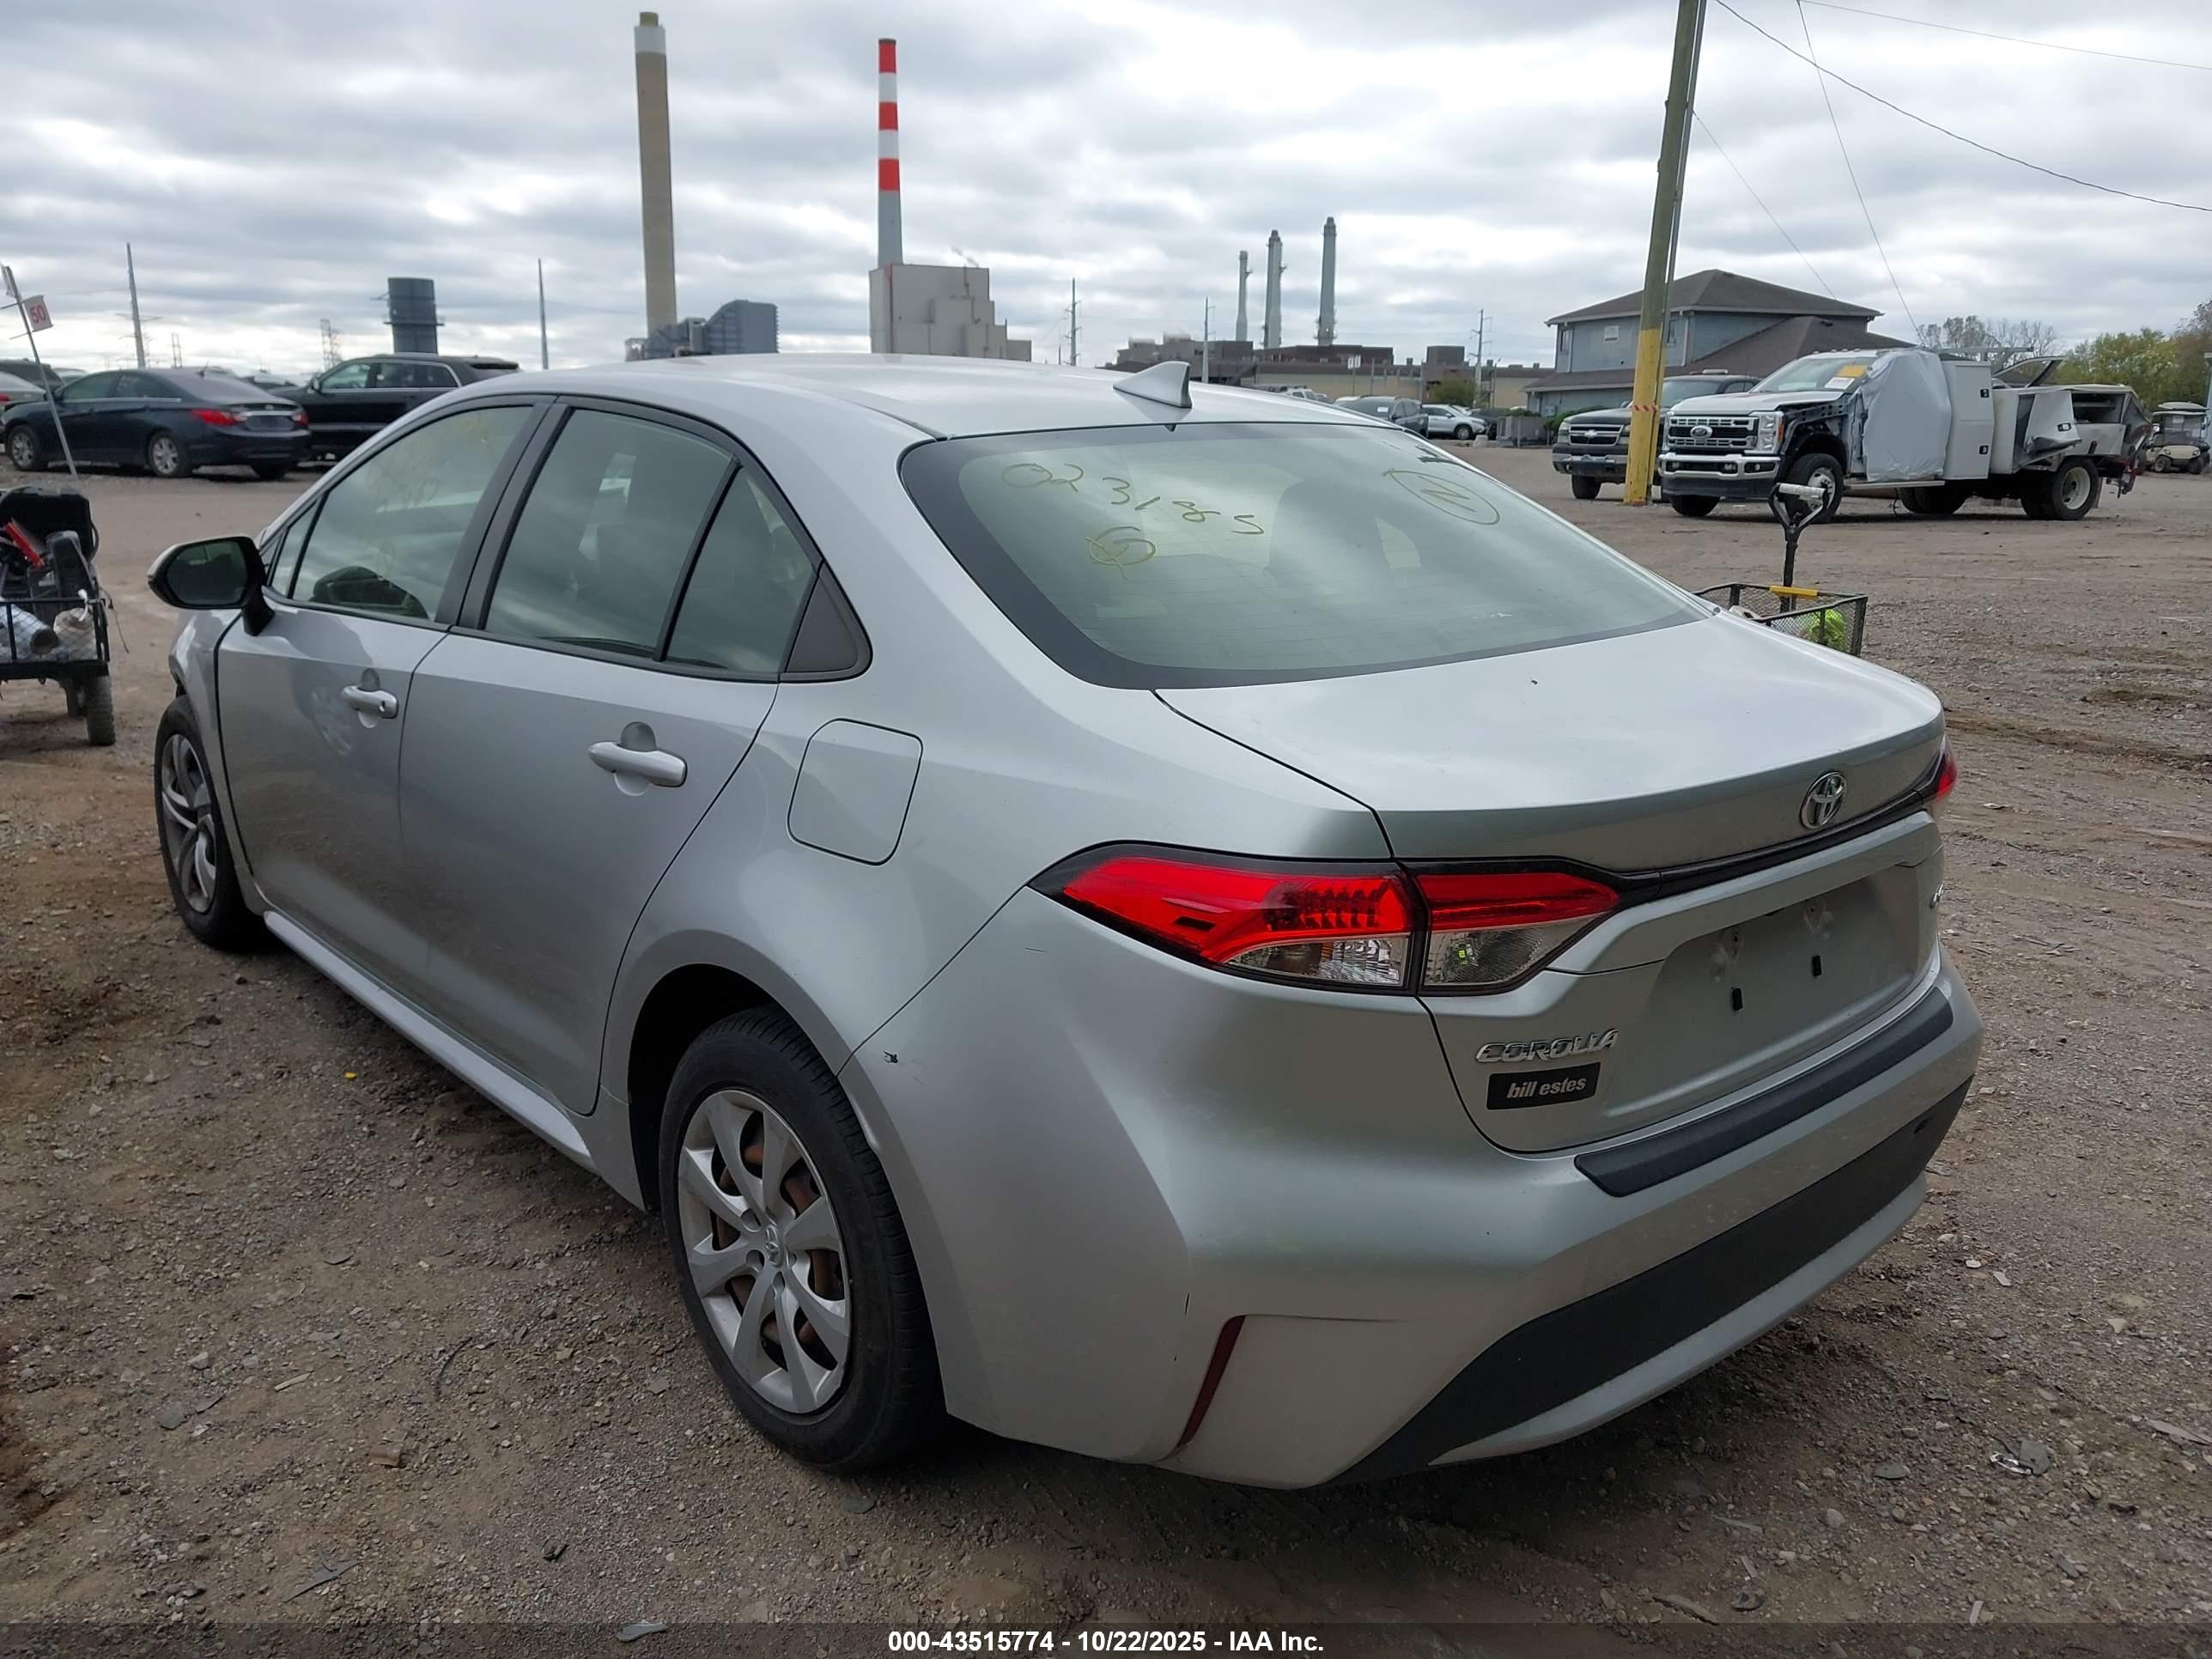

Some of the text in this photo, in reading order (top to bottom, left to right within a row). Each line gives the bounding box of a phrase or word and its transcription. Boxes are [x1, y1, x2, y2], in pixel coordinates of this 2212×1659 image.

[29, 303, 46, 324] 50
[1475, 1028, 1620, 1063] COROLLA
[1506, 1077, 1588, 1099] bill estes
